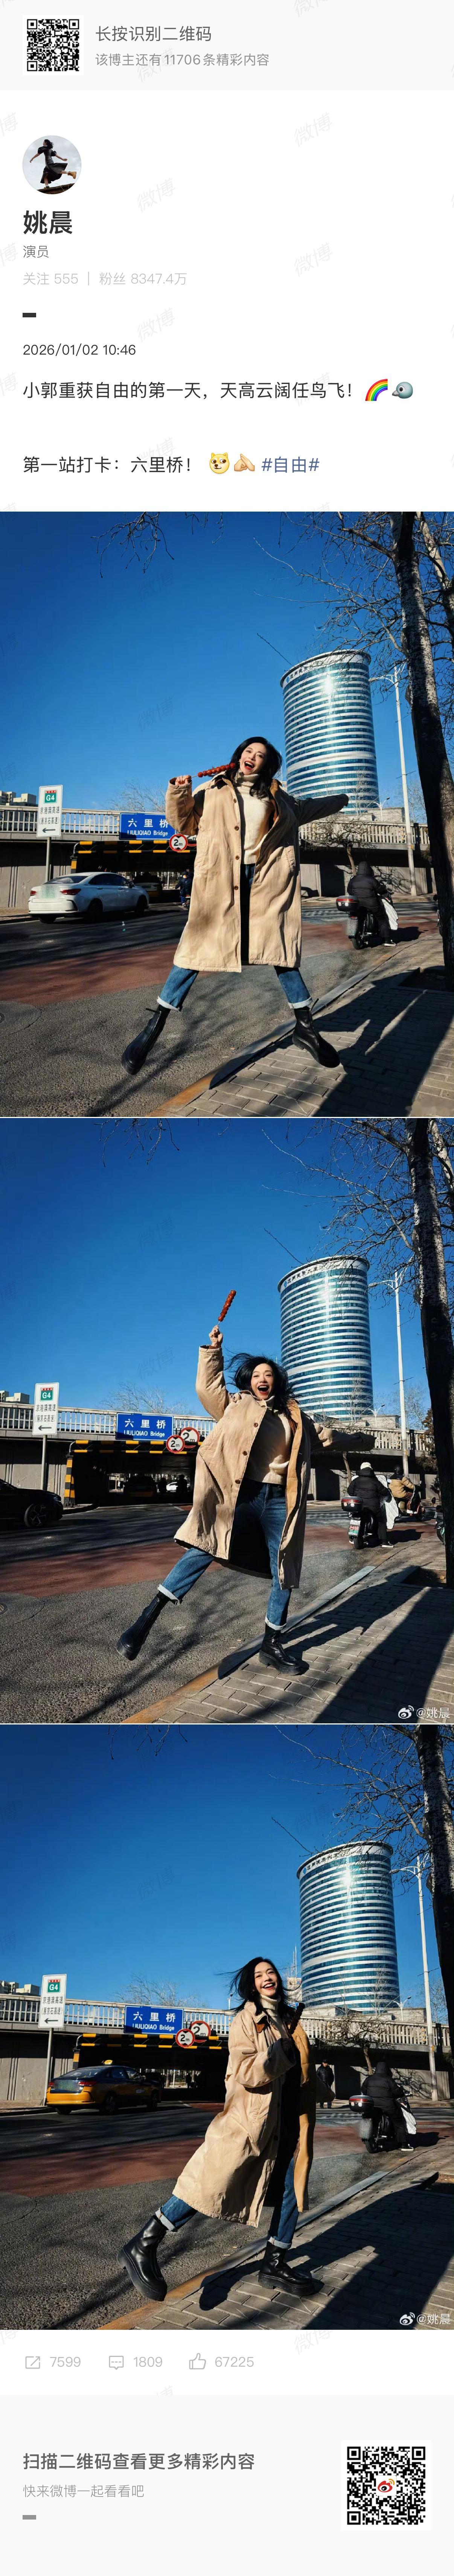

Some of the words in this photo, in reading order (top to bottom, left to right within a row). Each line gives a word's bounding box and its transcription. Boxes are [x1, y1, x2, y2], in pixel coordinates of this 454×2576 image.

[128, 818, 168, 828] 六里桥
[125, 1418, 166, 1429] 六里桥
[133, 2011, 176, 2023] 六里桥
